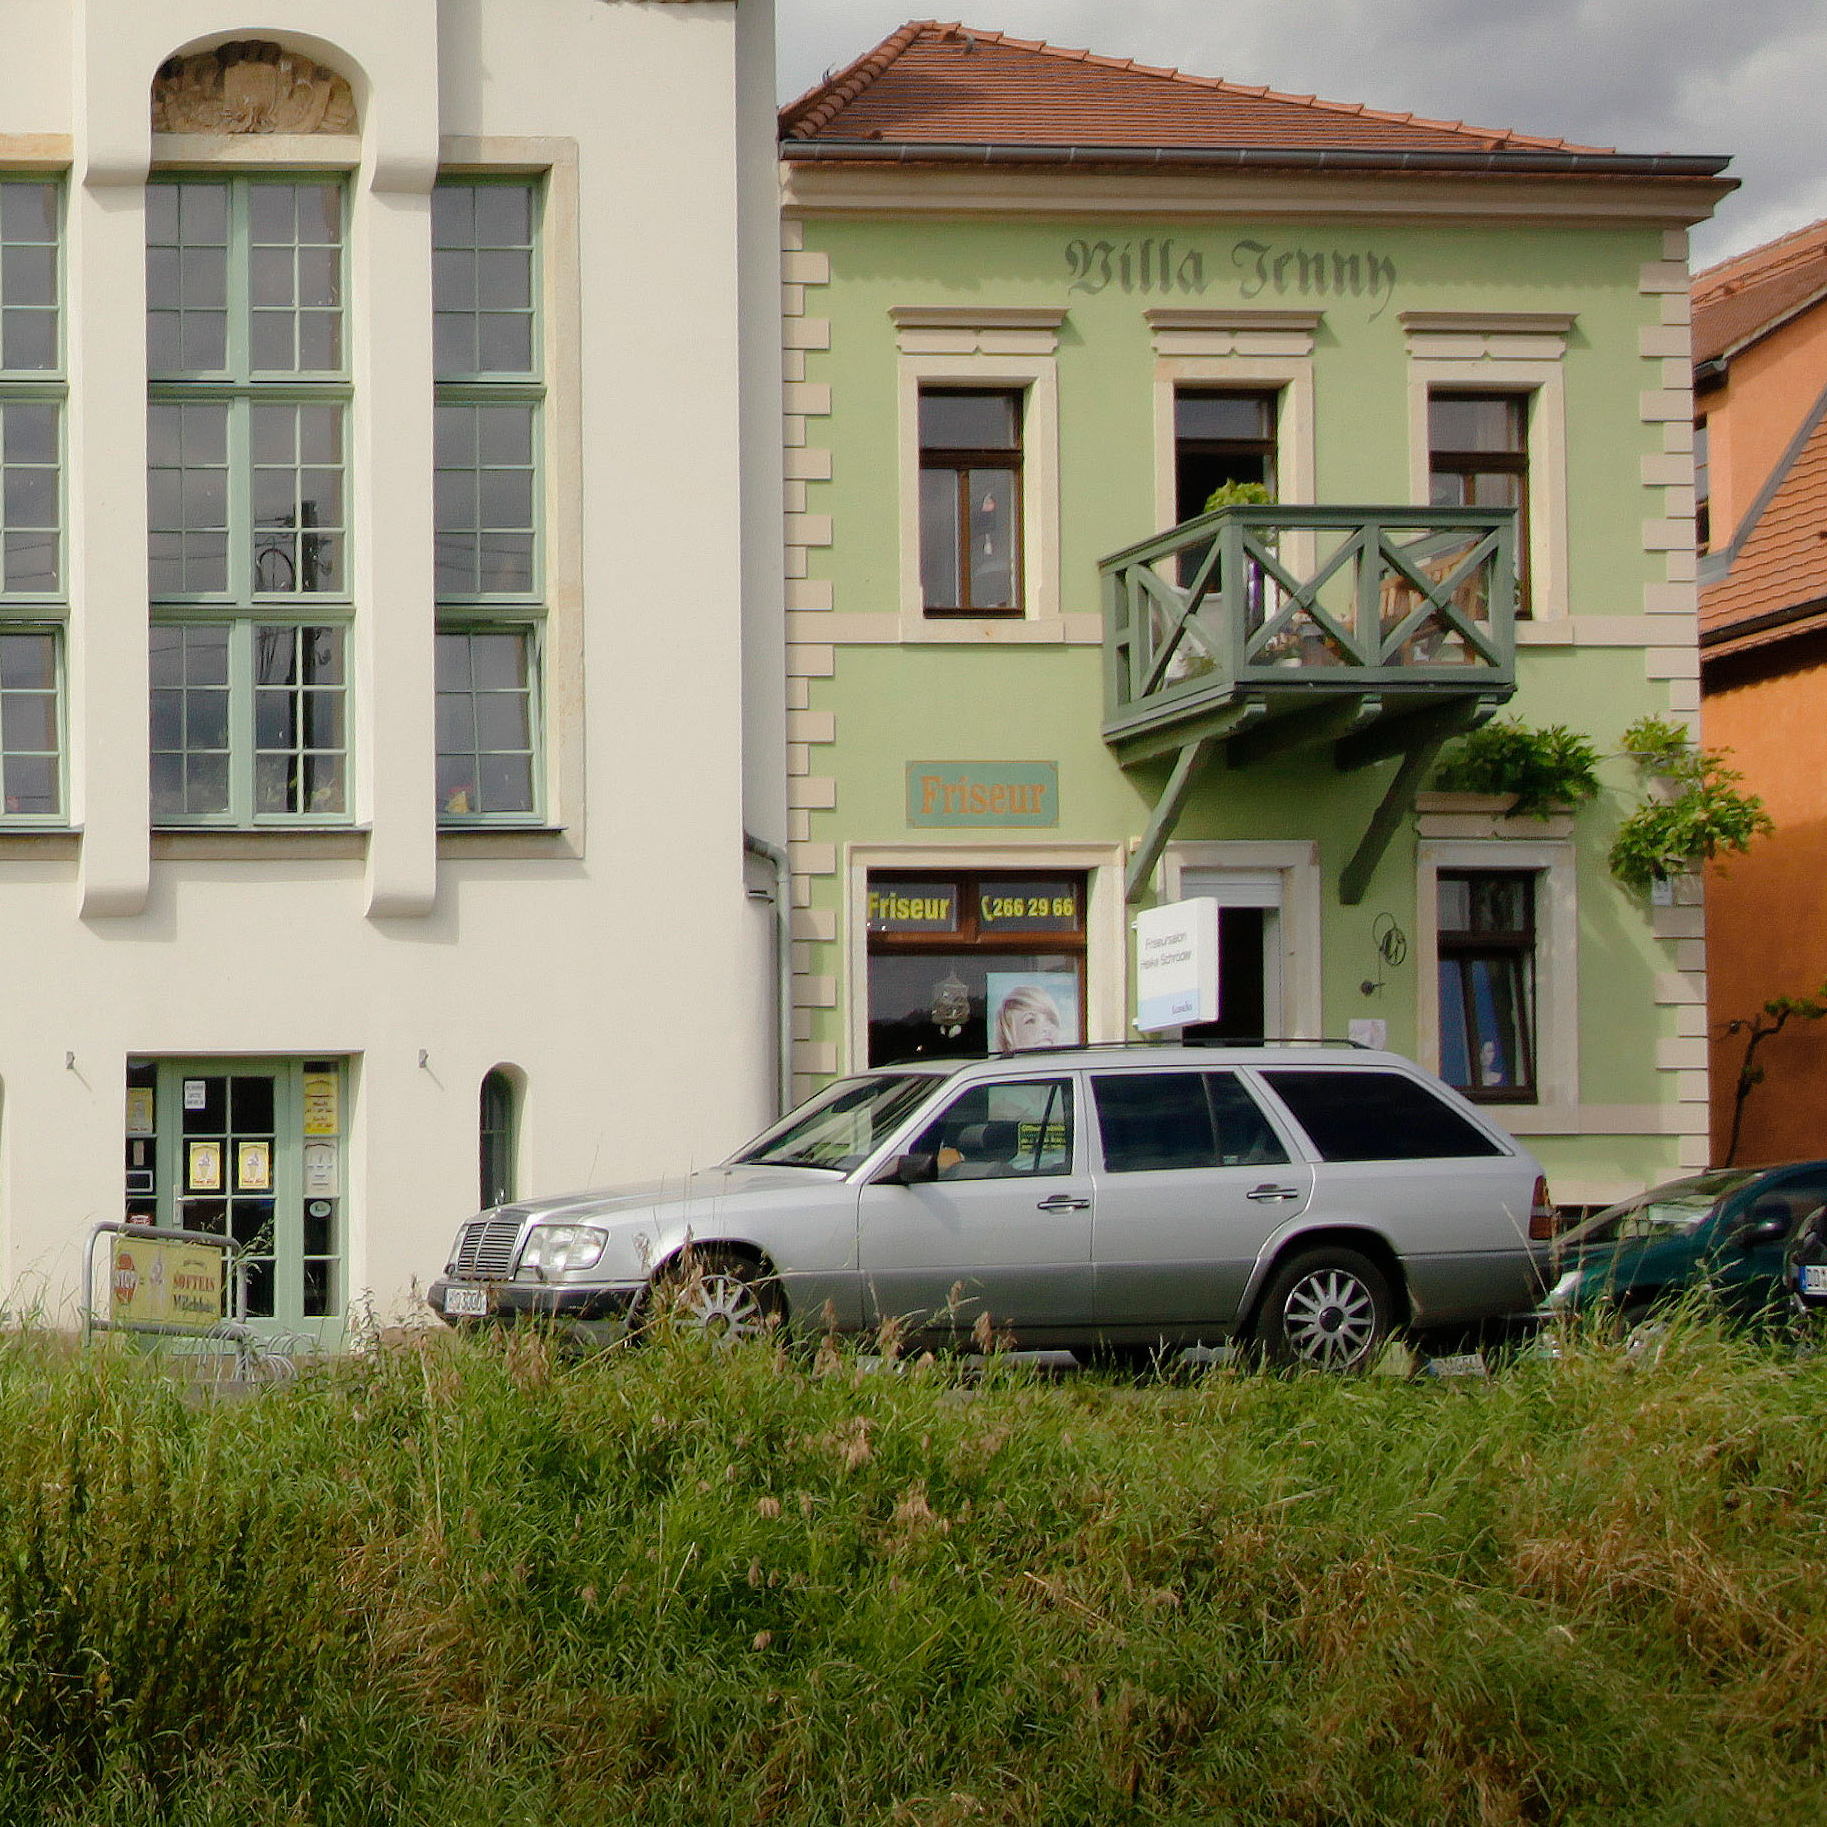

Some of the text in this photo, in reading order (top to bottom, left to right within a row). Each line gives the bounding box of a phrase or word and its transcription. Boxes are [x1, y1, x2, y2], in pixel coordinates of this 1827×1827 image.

[1064, 236, 1397, 323] Villa Jenny
[920, 775, 1046, 815] Friseur
[867, 891, 951, 921] Friseur
[992, 897, 1076, 918] 266 29 66
